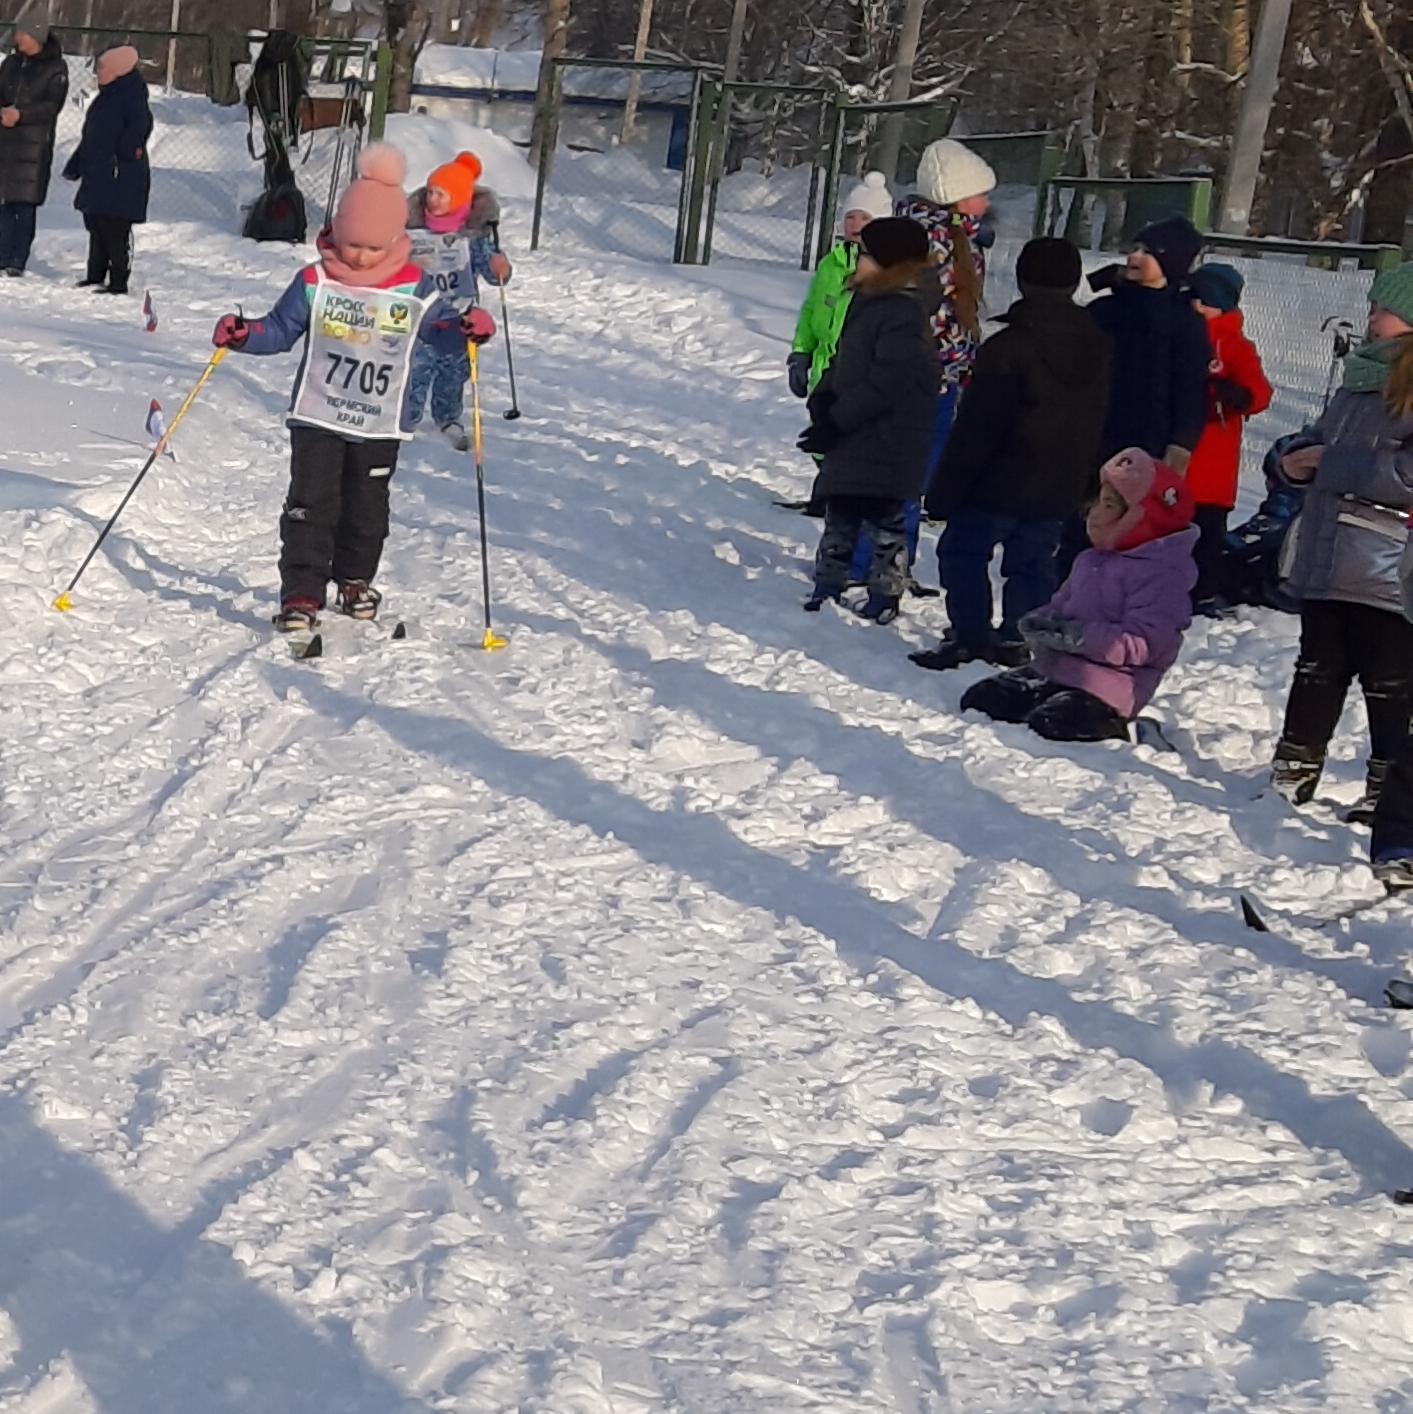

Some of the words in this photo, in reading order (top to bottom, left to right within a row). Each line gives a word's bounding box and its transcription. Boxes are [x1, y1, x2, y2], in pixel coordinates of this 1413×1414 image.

[427, 271, 459, 292] 02
[325, 294, 365, 313] КРОСС
[323, 308, 375, 329] НАЦИИ
[325, 351, 394, 397] 7705
